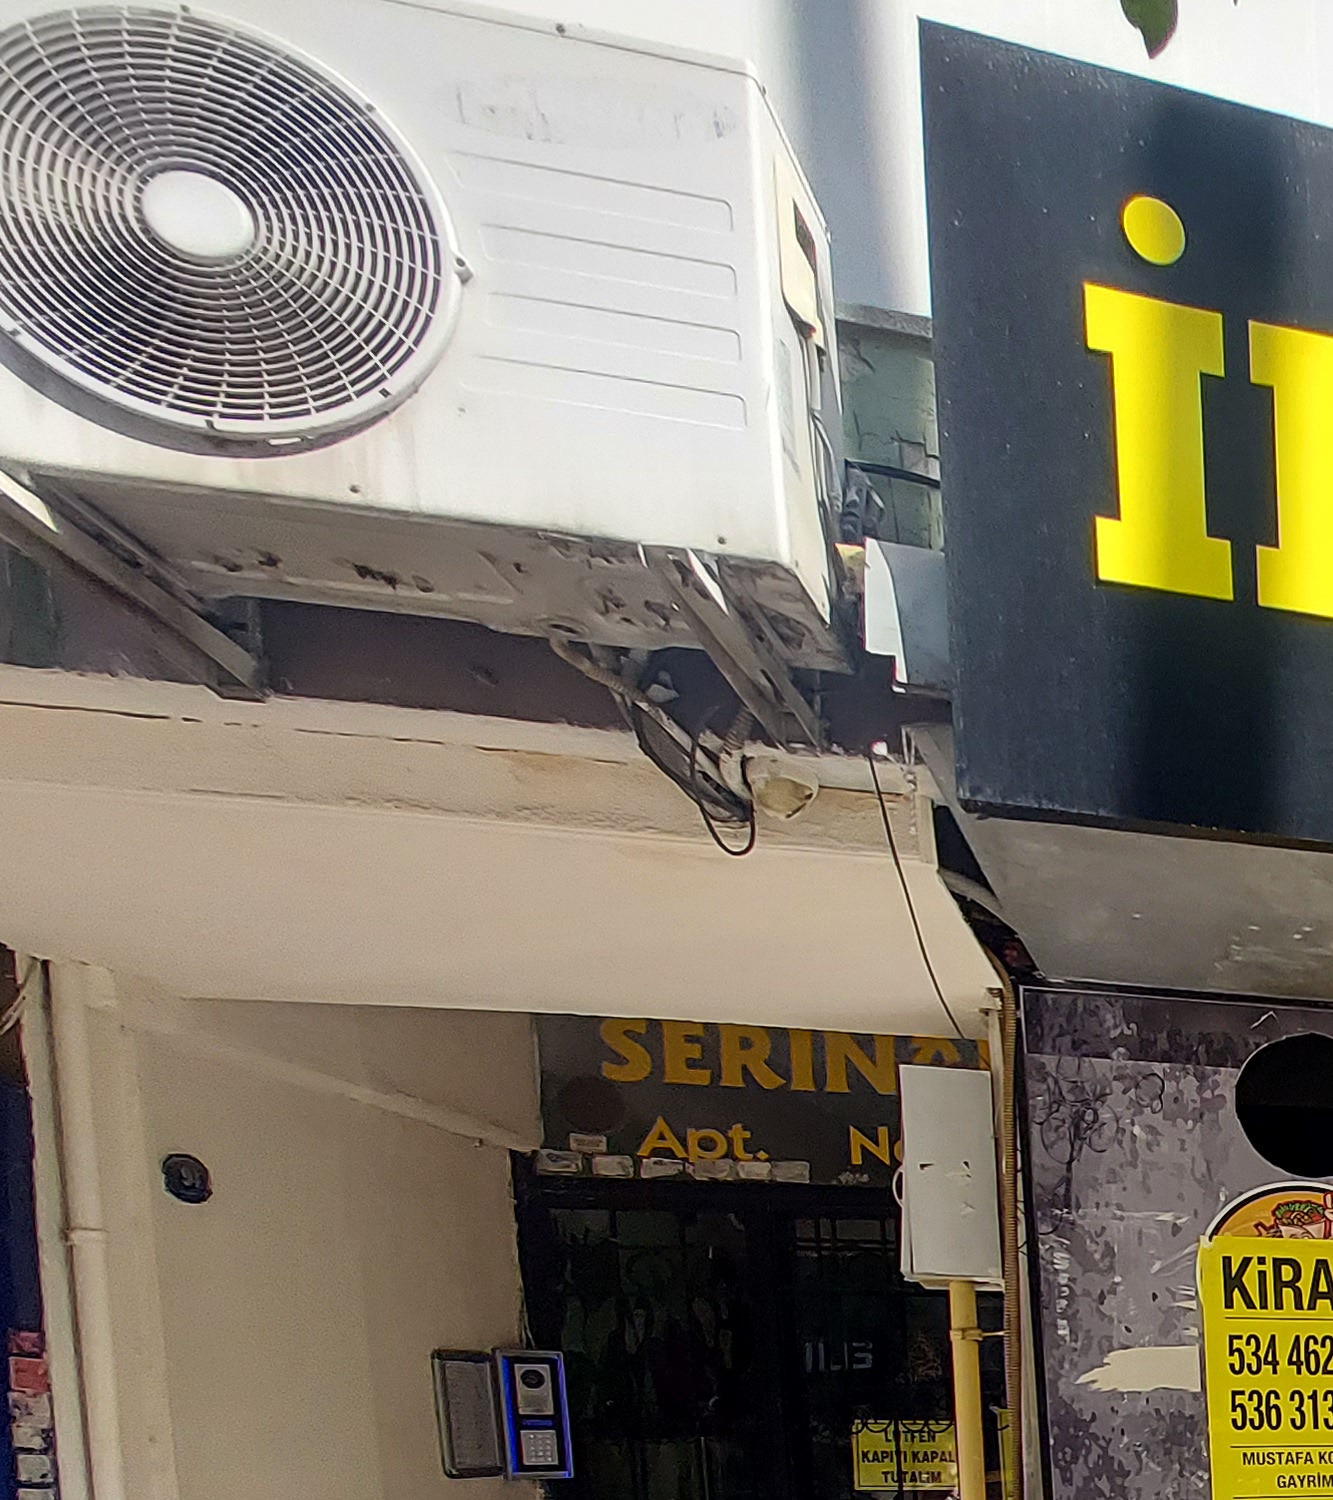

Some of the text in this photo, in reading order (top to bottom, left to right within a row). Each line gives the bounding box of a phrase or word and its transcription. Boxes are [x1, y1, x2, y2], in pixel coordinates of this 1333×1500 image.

[637, 1115, 770, 1162] Apt.
[1228, 1334, 1279, 1376] 534
[1231, 1389, 1282, 1431] 536
[884, 1430, 937, 1444] LTFEN
[911, 1450, 956, 1464] KAPAL
[1242, 1451, 1314, 1466] MUSTAFA
